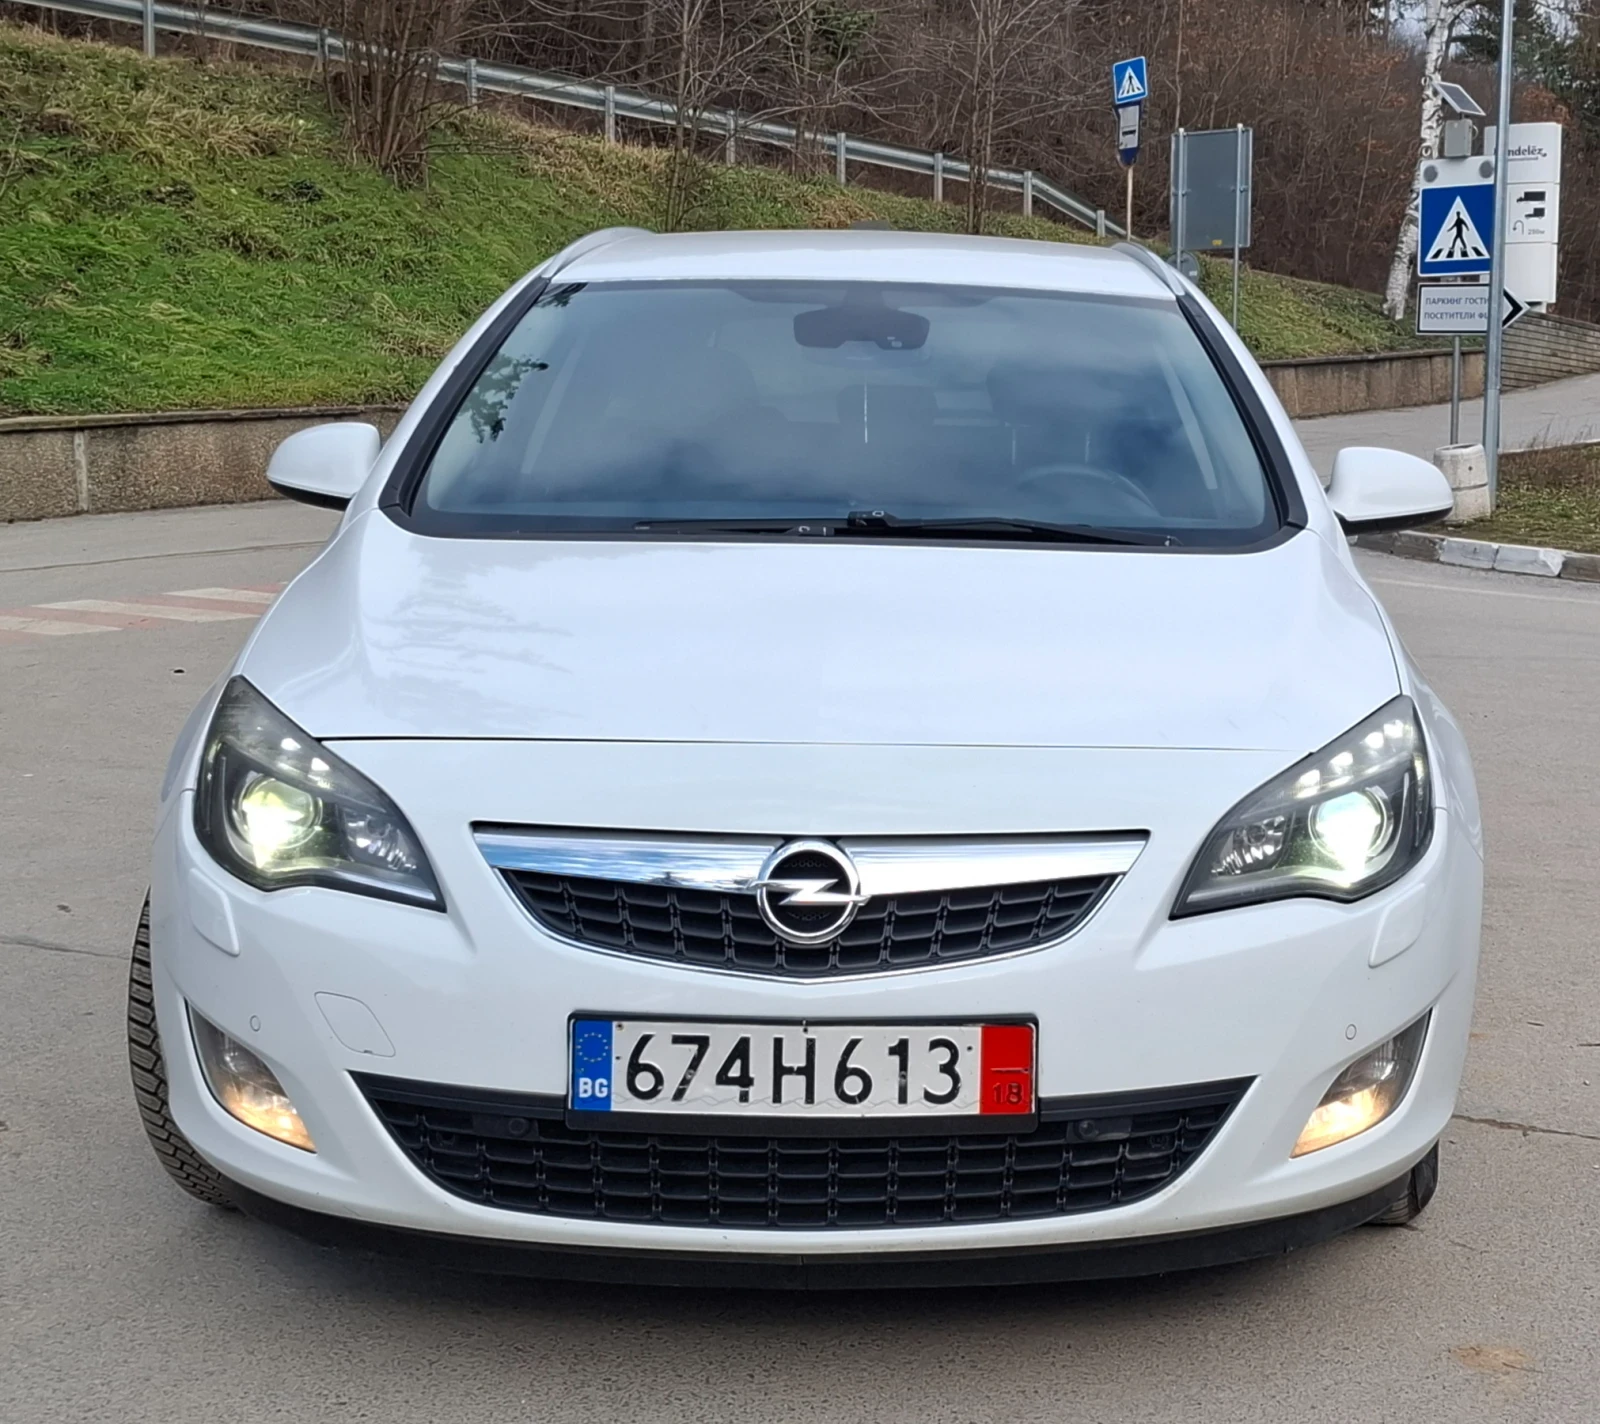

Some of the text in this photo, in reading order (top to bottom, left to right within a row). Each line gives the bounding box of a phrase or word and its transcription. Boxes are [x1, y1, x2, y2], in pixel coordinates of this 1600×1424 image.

[1425, 297, 1462, 305] ПАРКИНГ
[1424, 311, 1475, 320] ПОСЕТИТЕЛИ
[578, 1077, 609, 1098] BG
[992, 1082, 1022, 1104] 18
